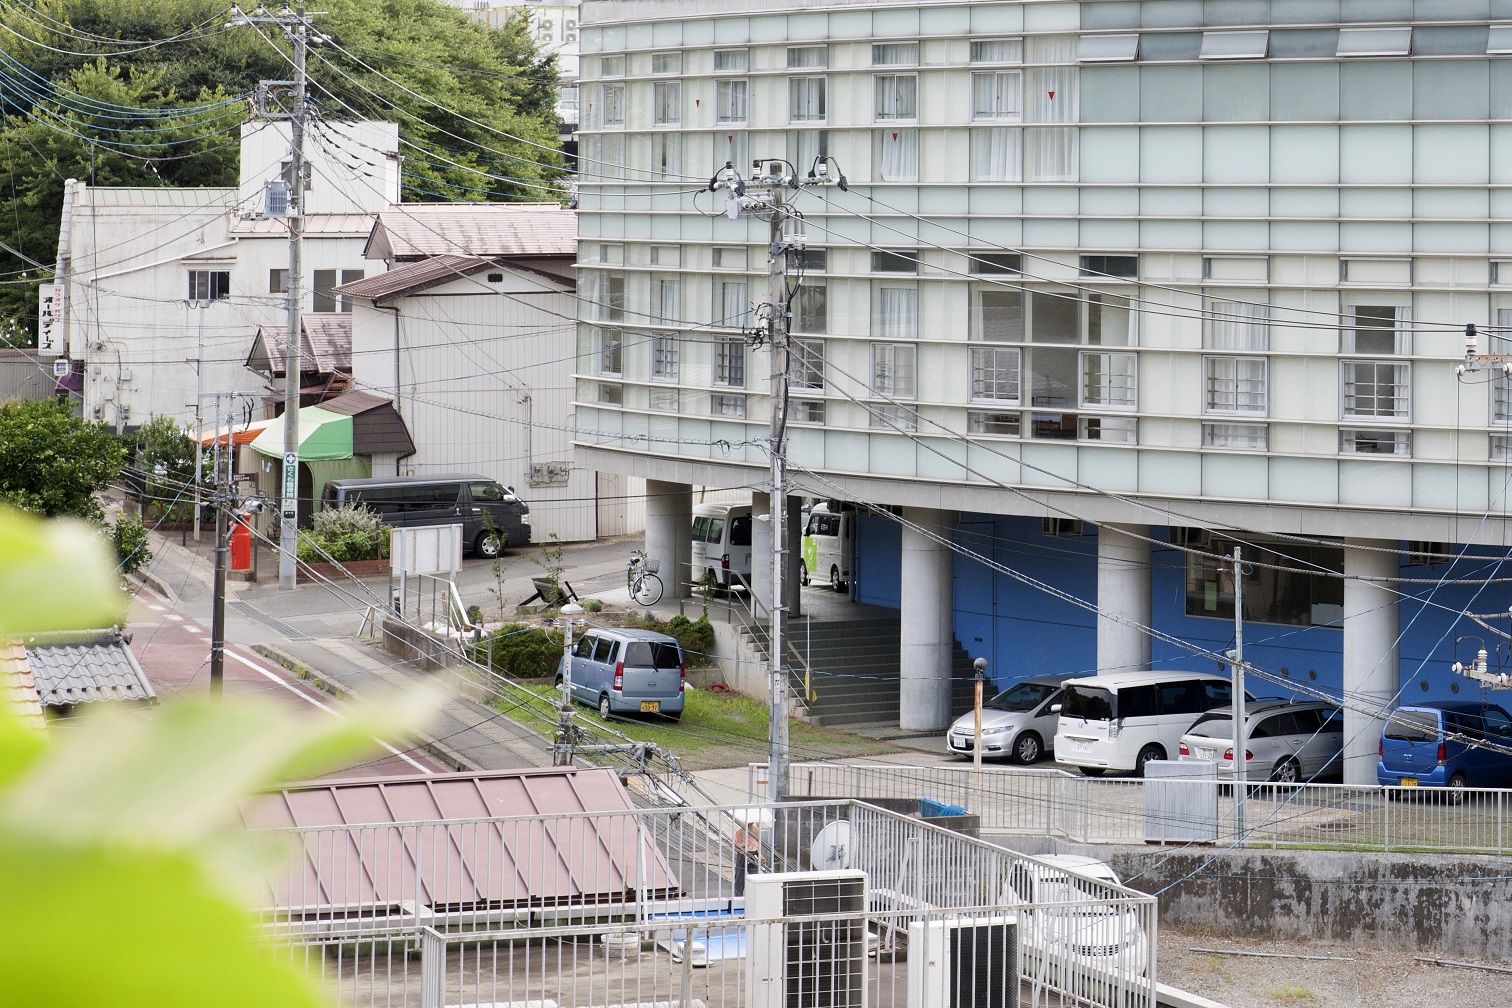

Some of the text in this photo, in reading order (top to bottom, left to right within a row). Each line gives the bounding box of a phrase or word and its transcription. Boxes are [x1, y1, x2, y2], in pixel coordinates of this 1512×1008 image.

[42, 296, 55, 350] オールディーズ
